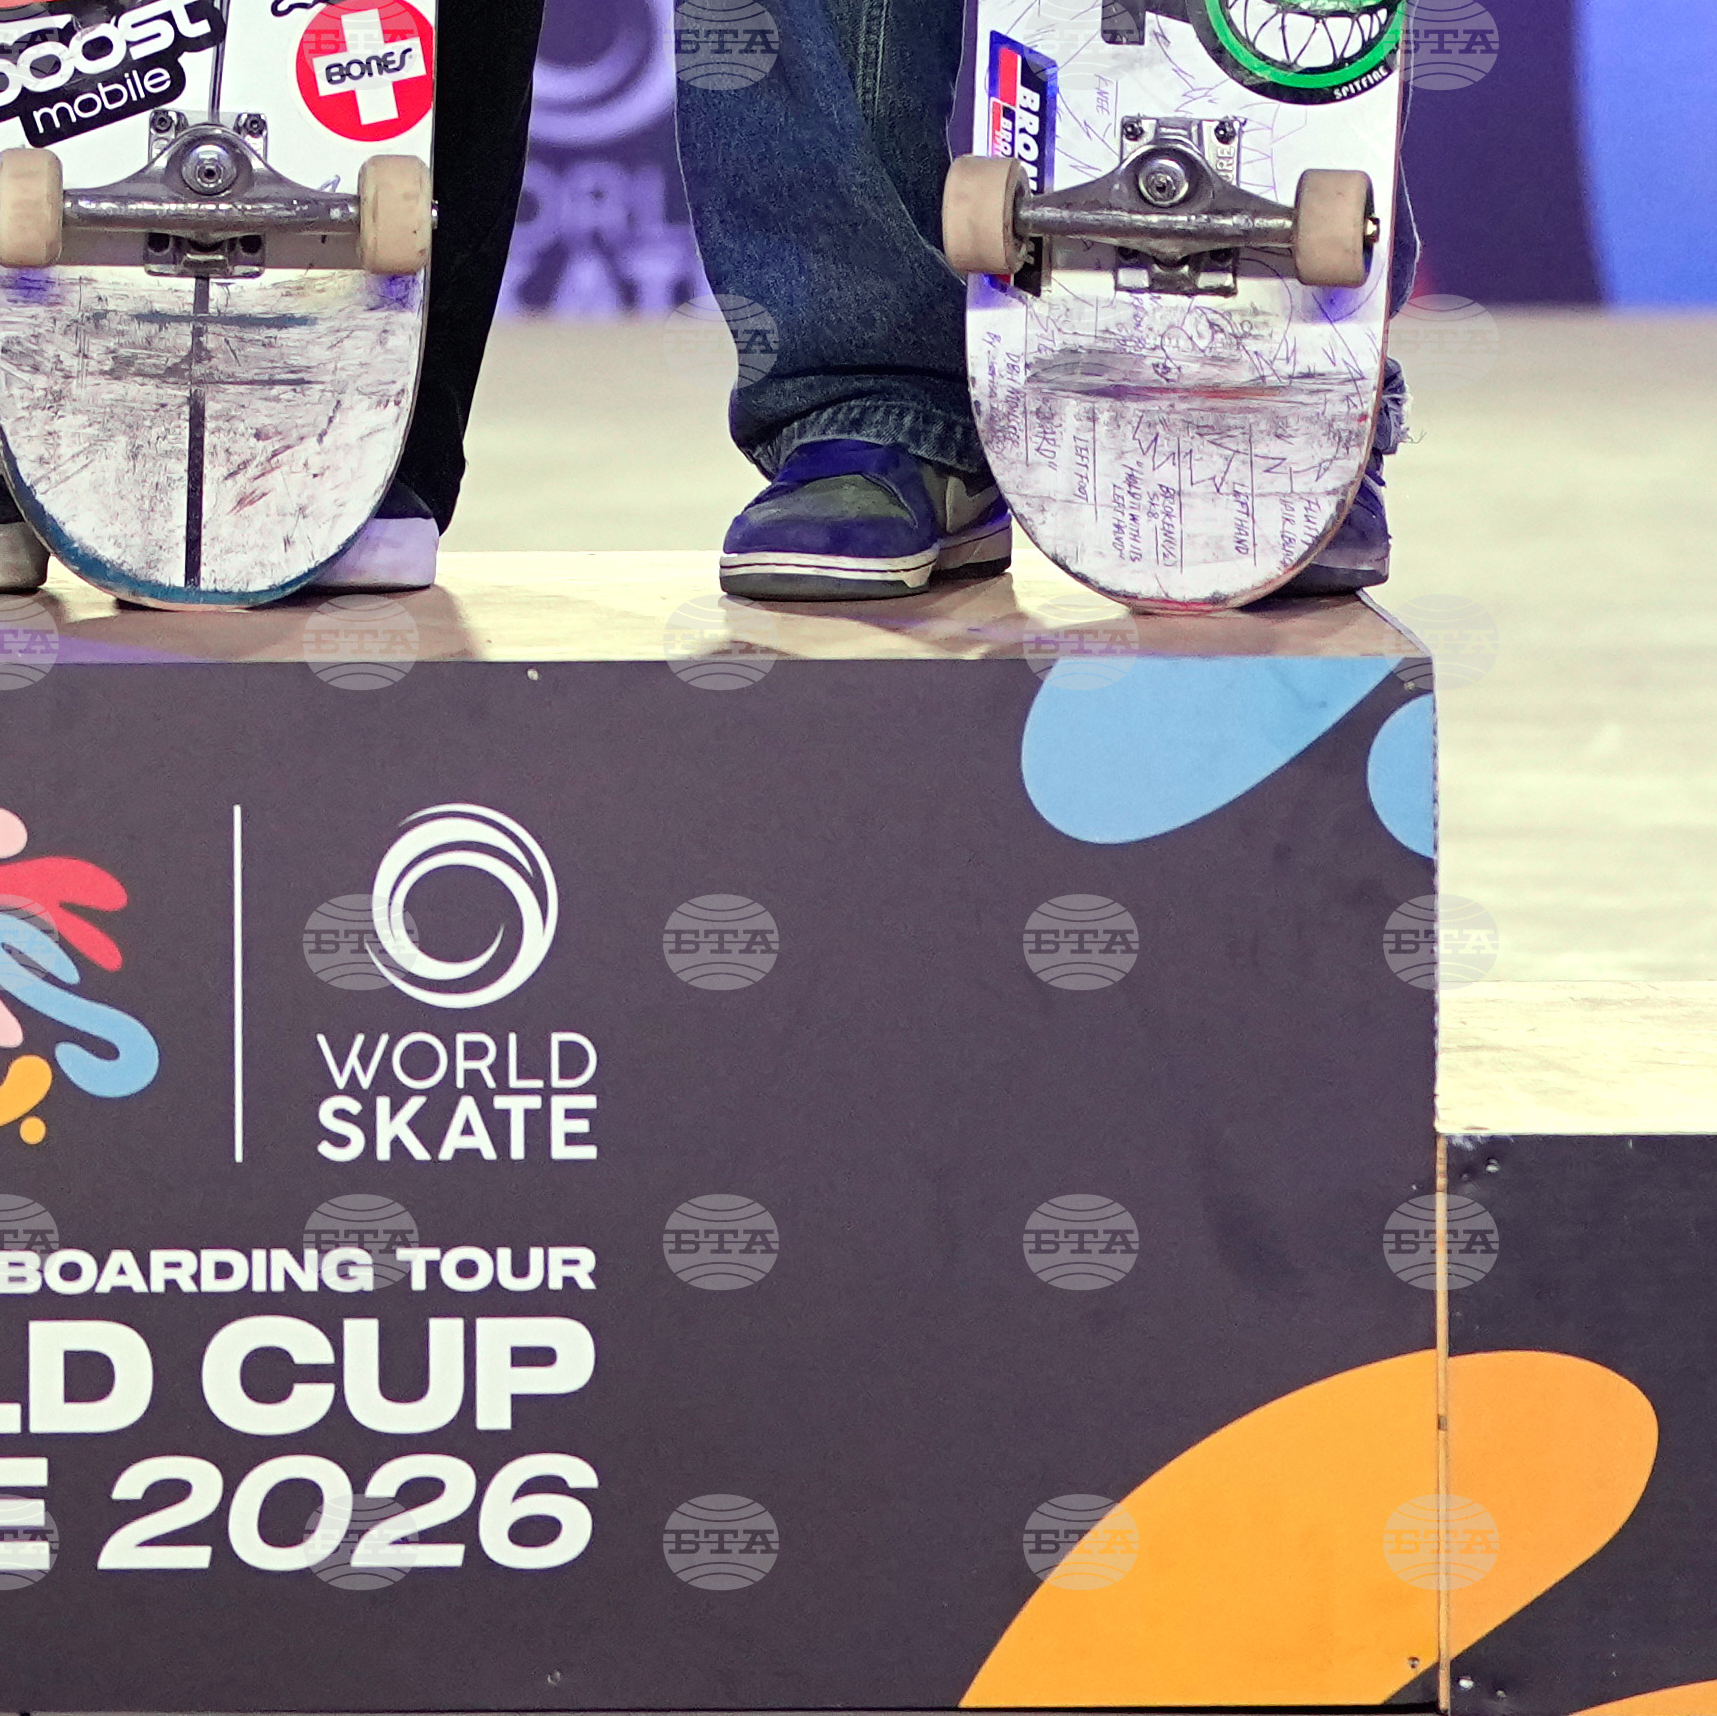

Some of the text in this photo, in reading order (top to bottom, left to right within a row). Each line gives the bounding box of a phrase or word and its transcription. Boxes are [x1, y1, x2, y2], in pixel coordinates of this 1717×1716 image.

[33, 67, 172, 135] mobile
[1333, 65, 1389, 100] SPITFIRE
[1073, 435, 1090, 503] LEFT FOOT
[1234, 517, 1250, 555] HAND
[316, 1031, 598, 1090] WORLD
[316, 1095, 598, 1163] SKATE
[395, 1245, 597, 1292] TOUR
[201, 1314, 596, 1436] CUP
[97, 1452, 600, 1572] 2026
